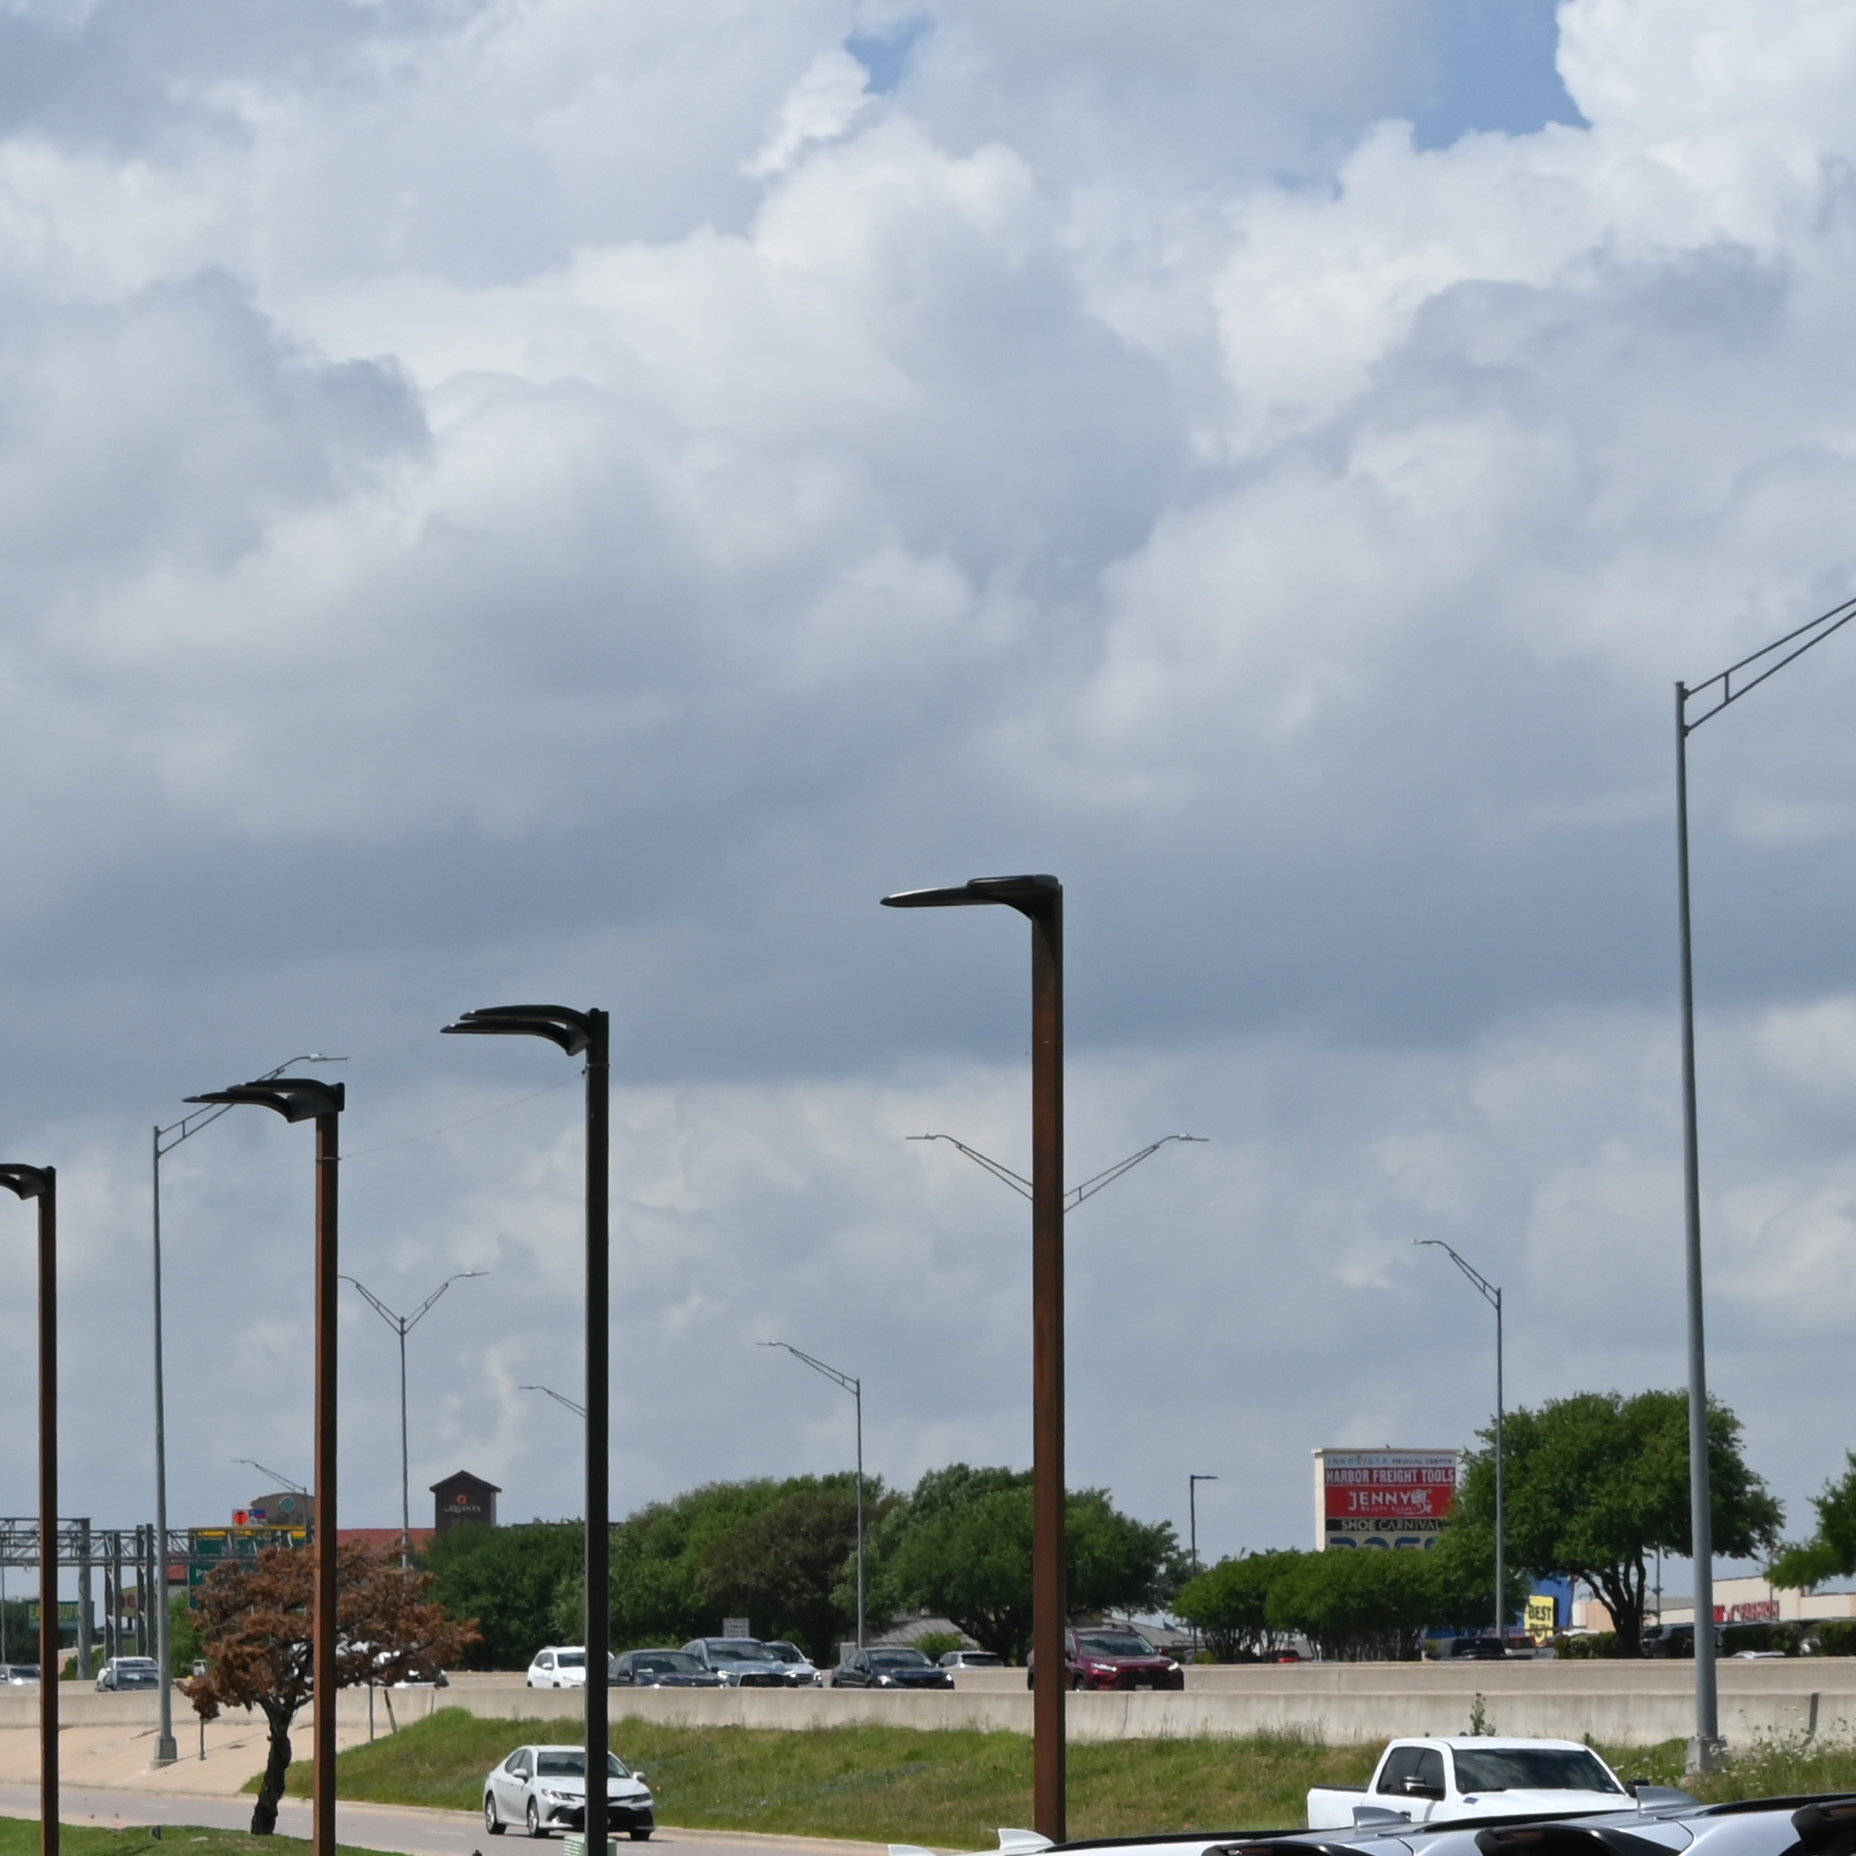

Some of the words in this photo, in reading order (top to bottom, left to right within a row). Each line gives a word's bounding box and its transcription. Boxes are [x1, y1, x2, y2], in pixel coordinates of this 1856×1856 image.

[1327, 1469, 1370, 1484] HARBOR
[1373, 1469, 1418, 1483] FREIGHT
[1422, 1469, 1454, 1482] TOOLS
[1348, 1491, 1411, 1511] JENNY
[1341, 1519, 1376, 1530] SHOE
[1528, 1605, 1552, 1621] BEST
